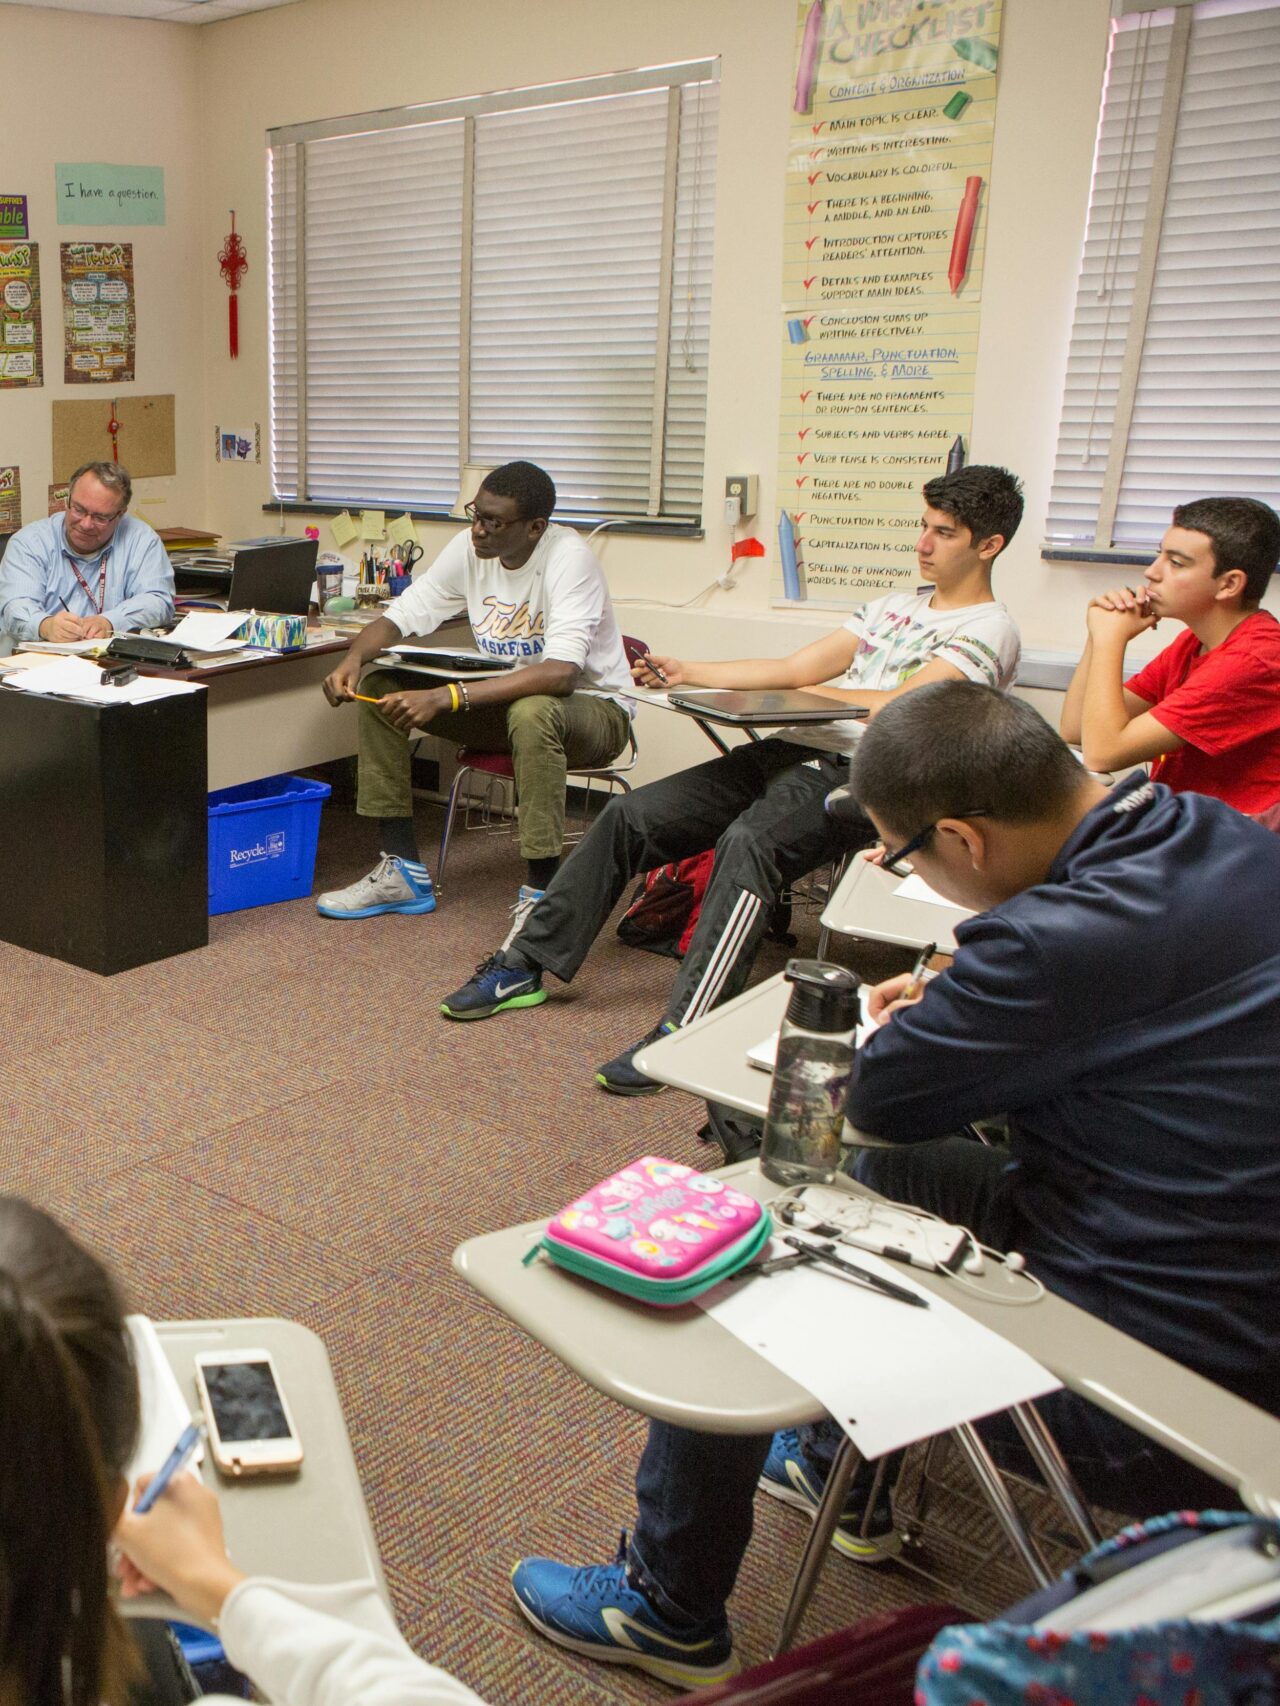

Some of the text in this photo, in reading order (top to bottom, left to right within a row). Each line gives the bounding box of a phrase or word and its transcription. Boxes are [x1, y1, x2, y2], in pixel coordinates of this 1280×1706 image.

[830, 81, 876, 98] CONTENT
[889, 69, 966, 90] ORGANIZATION
[830, 109, 939, 131] MAIN TOPIC IS CLEAR.
[826, 169, 888, 183] VOCABULARY
[891, 167, 900, 176] IS
[64, 182, 75, 198] I
[80, 182, 103, 198] have
[108, 189, 115, 198] a
[827, 198, 857, 209] THERE
[860, 197, 869, 206] IS
[872, 197, 878, 205] A
[824, 214, 830, 222] A
[874, 208, 893, 218] AND
[896, 208, 909, 216] AN
[912, 204, 933, 214] END.
[824, 230, 948, 248] INTRODUCTION CAPTURES
[870, 246, 925, 258] ATTENTION.
[822, 272, 933, 287] DETAILS AND EXAMPLES
[821, 286, 924, 301] SUPPORT MAIN IDEAS.
[821, 312, 928, 327] CONCLUSION SUMS UP
[820, 326, 924, 340] WRITING EFFECTIVELY.
[892, 364, 929, 377] MORE
[817, 391, 945, 401] THERE ARE NO FRAGMENTS
[816, 404, 928, 414] OR RUN-ON SENTENCES.
[808, 562, 912, 577] SPELLING OF UNKNOWN
[807, 577, 896, 588] WORDS IS CORRECT.
[477, 637, 546, 657] ASKEBA
